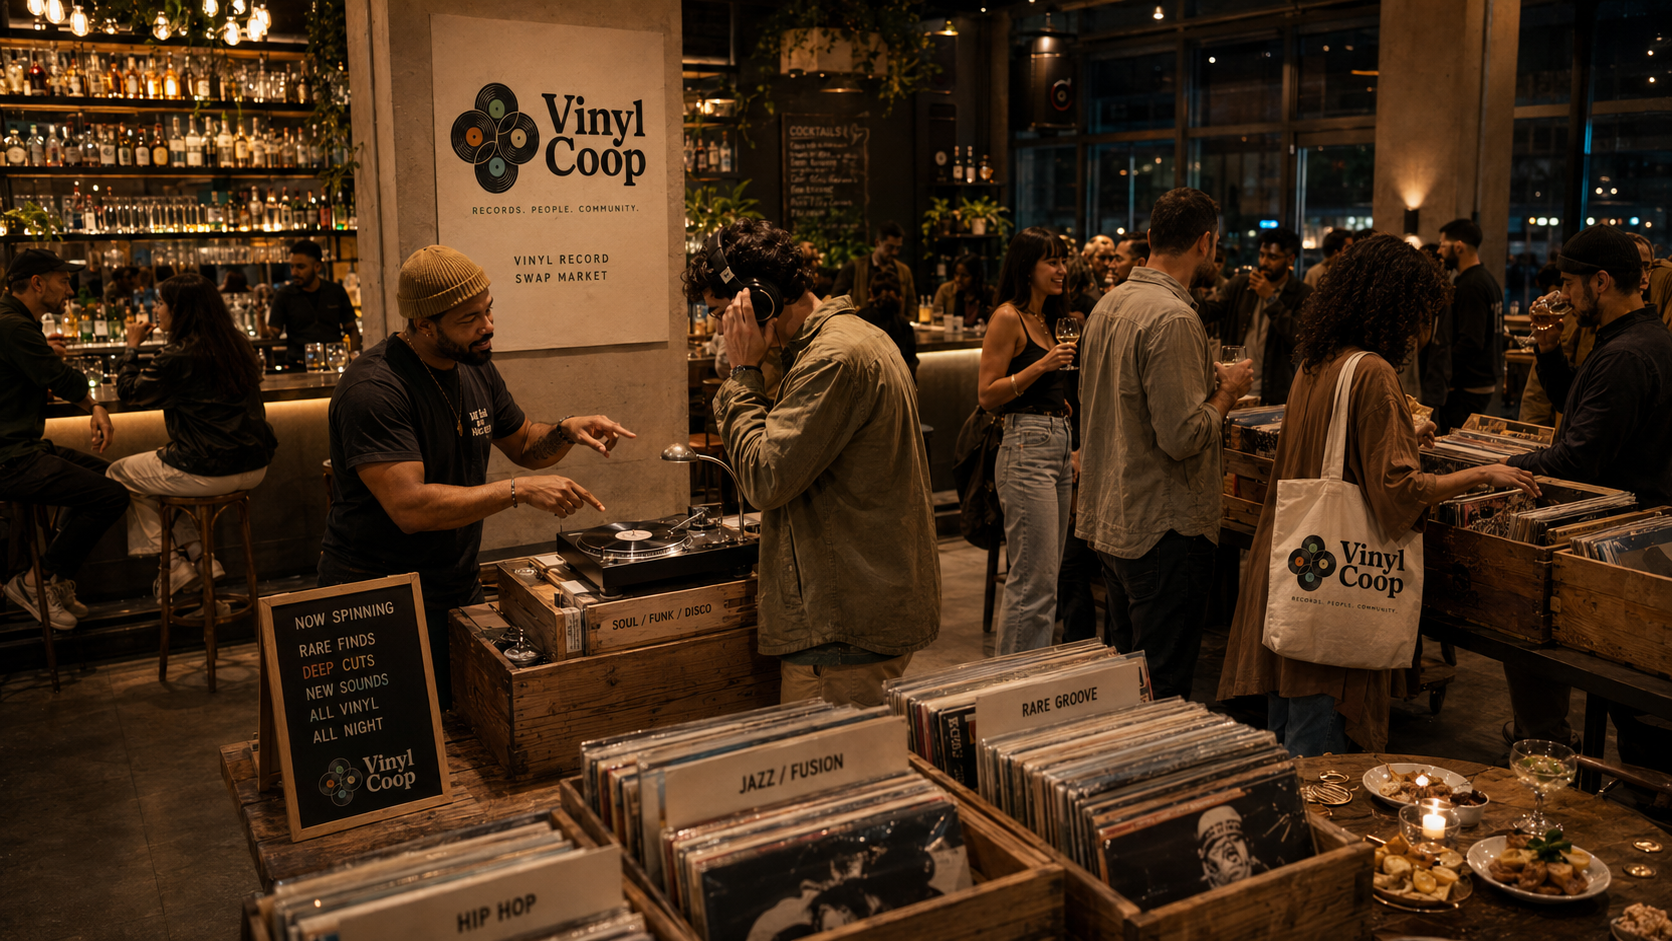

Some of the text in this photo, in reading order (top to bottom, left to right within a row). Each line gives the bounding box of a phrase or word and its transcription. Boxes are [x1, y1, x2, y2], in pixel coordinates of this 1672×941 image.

[541, 93, 646, 147] Vinyl
[789, 125, 841, 137] COCKTAILS
[545, 136, 646, 186] Coop
[472, 204, 639, 215] RECORDS. PEOPLE. COMMUNITY.
[513, 253, 609, 266] VINYL RECORD
[515, 270, 608, 284] SWAP MARKET
[1340, 540, 1405, 575] Vinyl
[1339, 564, 1404, 599] Coop
[294, 601, 394, 630] NOW SPINNING
[612, 617, 638, 630] SOUL
[649, 610, 674, 623] FUNK
[685, 603, 712, 617] DISCO
[299, 632, 376, 658] RARE FINDS
[302, 654, 375, 680] DEEP CUTS
[305, 673, 389, 701] NEW SOUNDS
[309, 697, 379, 722] ALL VINYL
[1022, 686, 1098, 717] RARE GROOVE
[313, 717, 383, 744] ALL NIGHT
[362, 749, 415, 774] Vinyl
[739, 768, 775, 794] JAZZ
[790, 753, 844, 781] FUSION
[366, 770, 416, 793] Coop
[457, 893, 537, 934] HIP HOP
